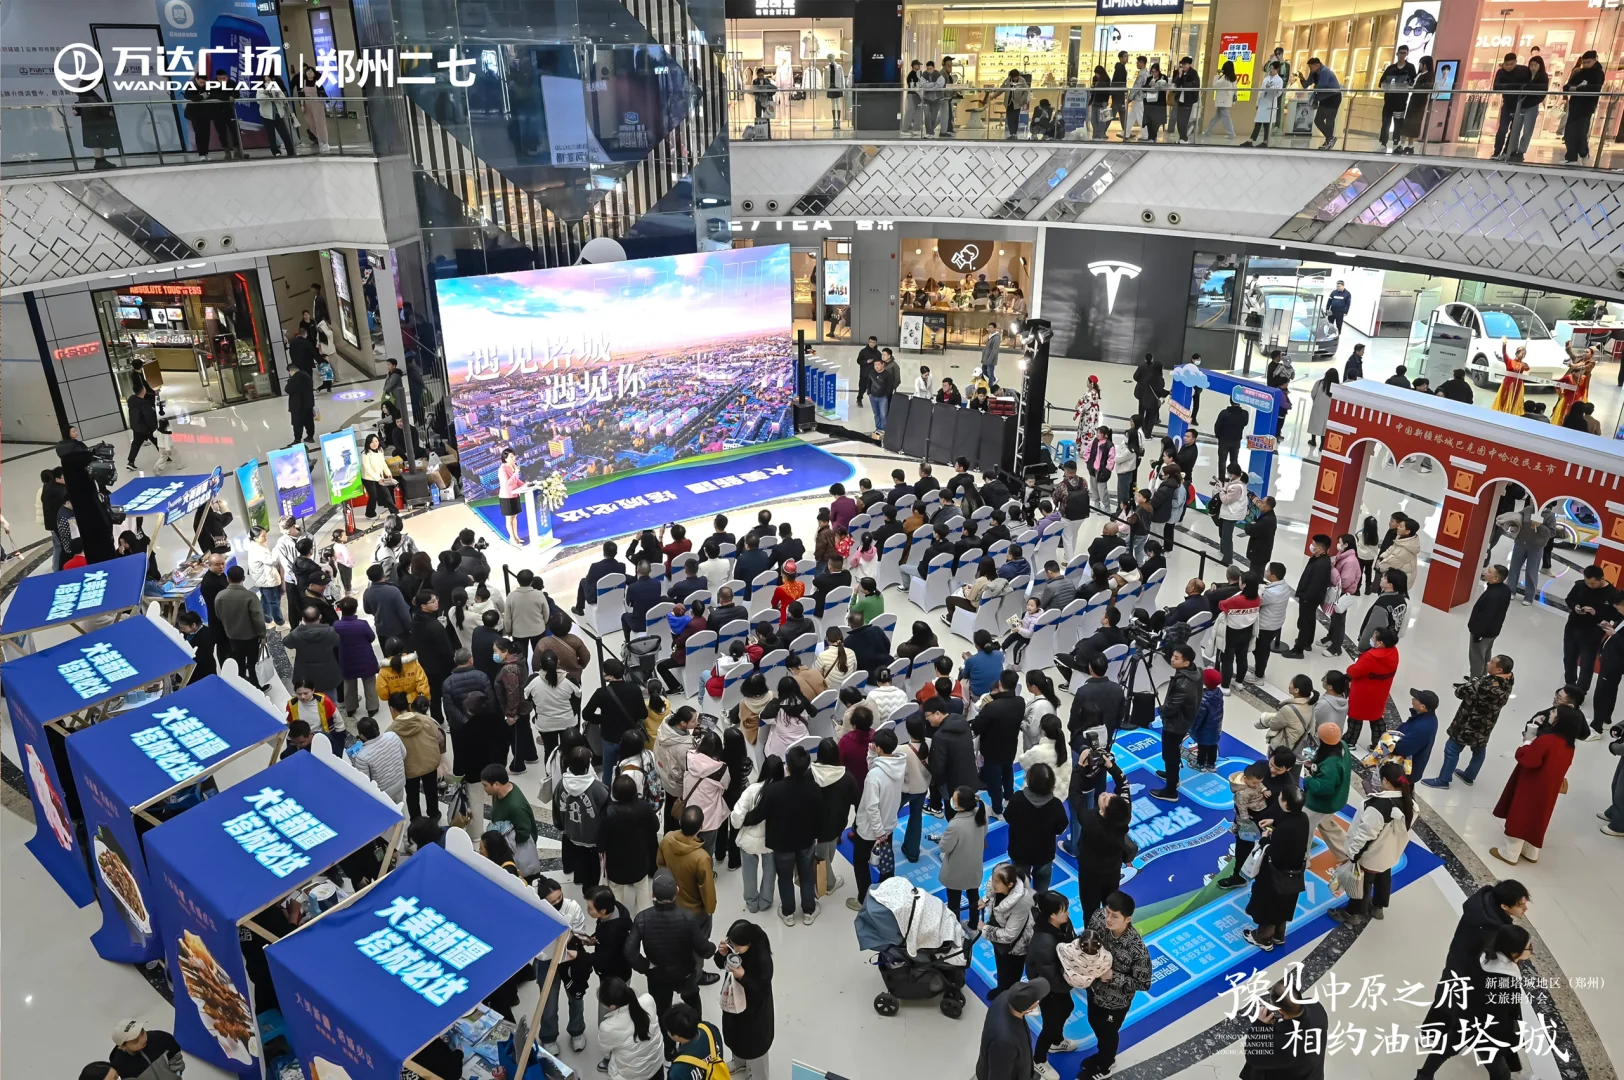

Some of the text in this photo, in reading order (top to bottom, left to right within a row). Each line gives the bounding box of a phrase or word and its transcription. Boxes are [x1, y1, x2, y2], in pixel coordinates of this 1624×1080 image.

[129, 285, 202, 295] ABSOLUTE TOUGESS
[464, 331, 612, 382] 遇见塔城
[540, 363, 647, 412] 遇见你
[1395, 421, 1557, 475] 中国新疆塔城巴克图中哈边民互市
[684, 464, 793, 495] 大美新疆
[556, 490, 678, 523] 塔城必达
[45, 582, 84, 621] 塔城必达
[77, 570, 108, 610] 大美新疆
[57, 658, 112, 700] 塔城必达
[80, 641, 139, 683] 大美新疆
[130, 726, 206, 782] 塔城必达
[152, 706, 231, 760] 大美新疆
[243, 786, 339, 851] 大美新疆
[1128, 806, 1202, 849] 城必达
[221, 810, 312, 878] 塔城必达
[374, 895, 494, 971] 大美新疆
[354, 927, 470, 1008] 塔城必达
